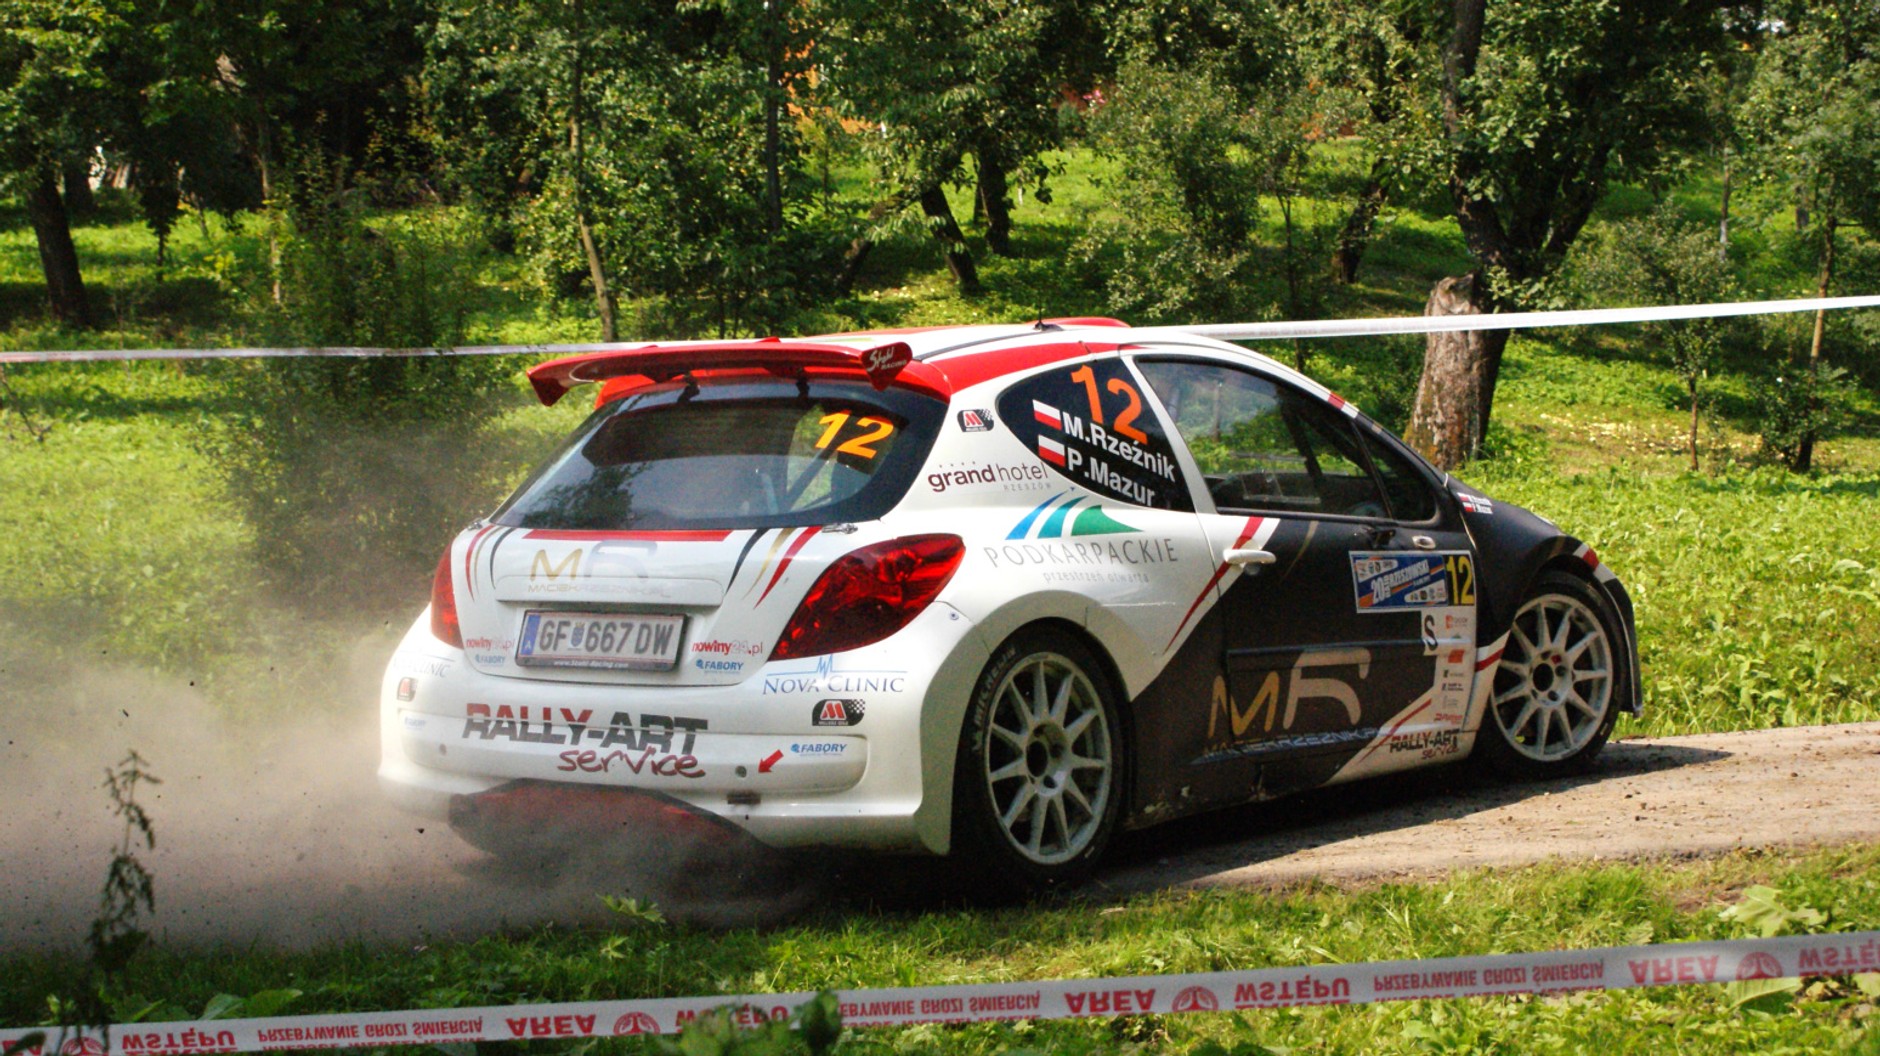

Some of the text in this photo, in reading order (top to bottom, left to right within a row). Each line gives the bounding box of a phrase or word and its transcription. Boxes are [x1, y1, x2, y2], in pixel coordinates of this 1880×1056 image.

[1071, 365, 1148, 445] 12
[815, 408, 894, 460] 12
[1062, 411, 1176, 483] M.Rzeźnik
[984, 538, 1179, 568] PODKARPACKIE
[1446, 556, 1475, 605] 12
[539, 620, 674, 656] GF 667 DW
[1424, 614, 1439, 651] S
[704, 660, 745, 671] FABORY
[827, 674, 905, 694] CLINIC
[462, 702, 709, 756] RALLY-ART
[1389, 728, 1462, 753] RALLY-ART
[557, 746, 707, 778] service
[800, 743, 848, 754] FABORY
